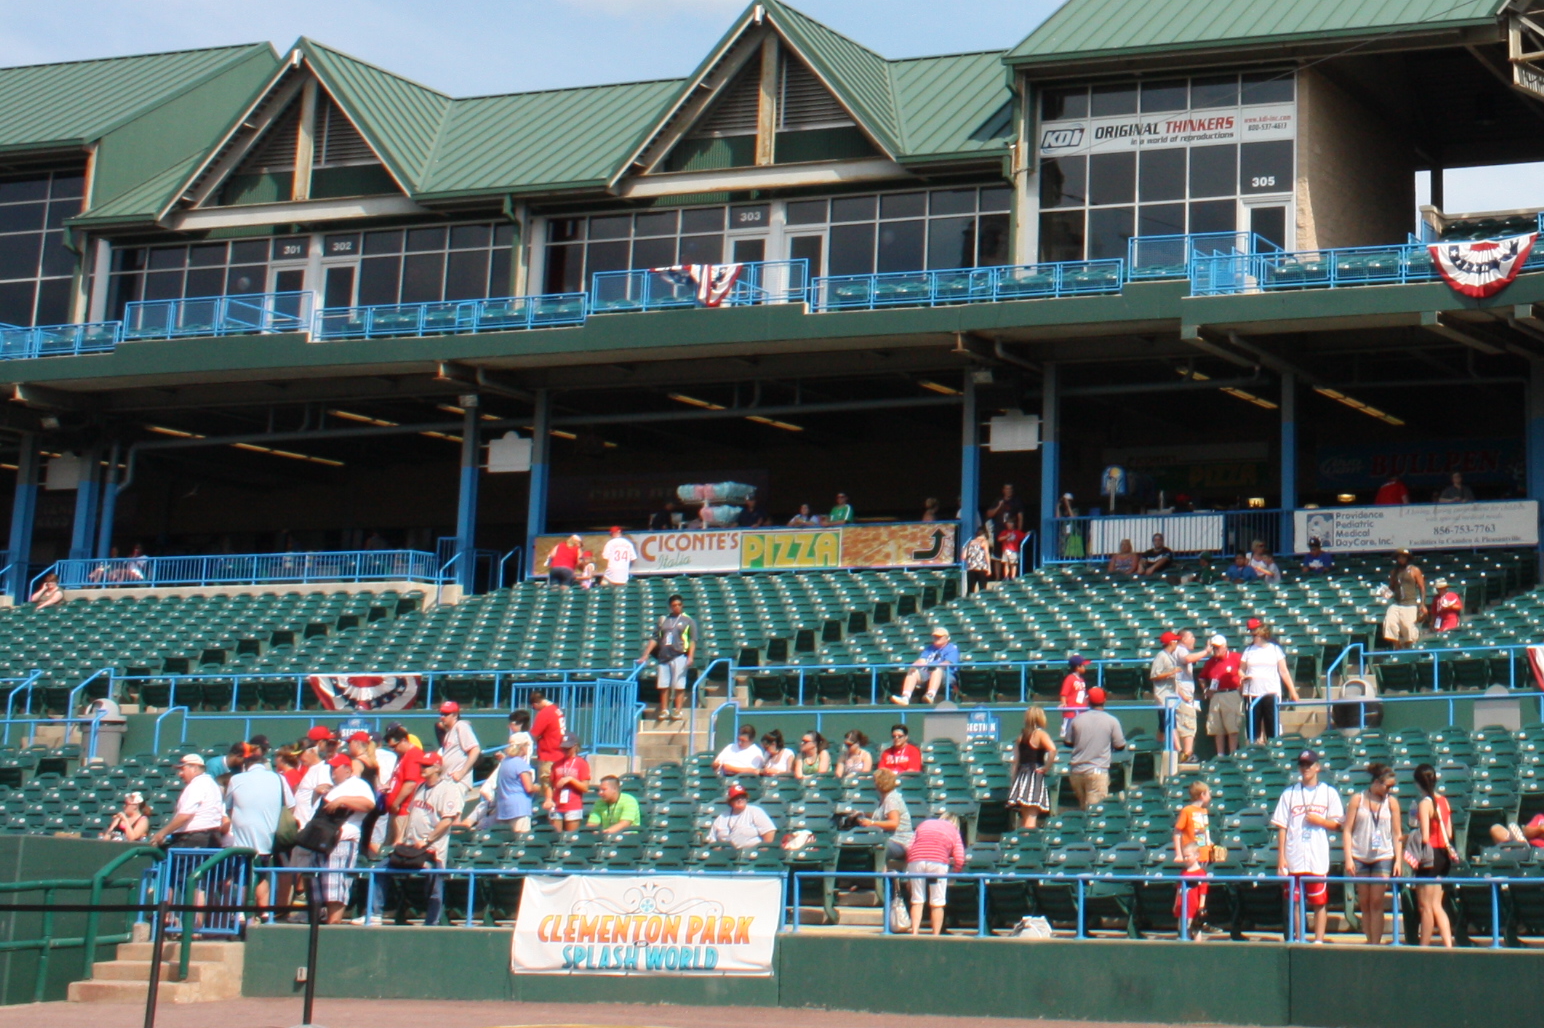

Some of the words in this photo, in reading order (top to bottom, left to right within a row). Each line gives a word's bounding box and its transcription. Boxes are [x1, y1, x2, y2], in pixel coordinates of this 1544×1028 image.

[1095, 122, 1160, 140] ORIGINAL
[1165, 116, 1235, 134] THINKERS
[1147, 136, 1169, 145] world
[1170, 135, 1178, 143] of
[1180, 131, 1234, 142] reproductions
[1252, 176, 1275, 187] 305
[740, 211, 761, 222] 303
[283, 245, 301, 255] 301
[332, 241, 353, 251] 302
[1369, 450, 1502, 477] BULLPEN
[1335, 512, 1384, 520] Providence
[1335, 520, 1374, 529] Pediatric
[1433, 524, 1496, 535] 856-753-7763
[1335, 529, 1371, 538] Medical
[1378, 537, 1393, 545] Inc.
[640, 531, 739, 562] CICONTE'S
[742, 532, 839, 569] PIZZA
[614, 550, 629, 562] 34
[656, 552, 692, 570] Italia
[537, 914, 682, 944] CLEMENTON
[684, 915, 754, 944] PARK
[561, 944, 640, 970] SPLASH
[644, 944, 720, 970] WORLD
